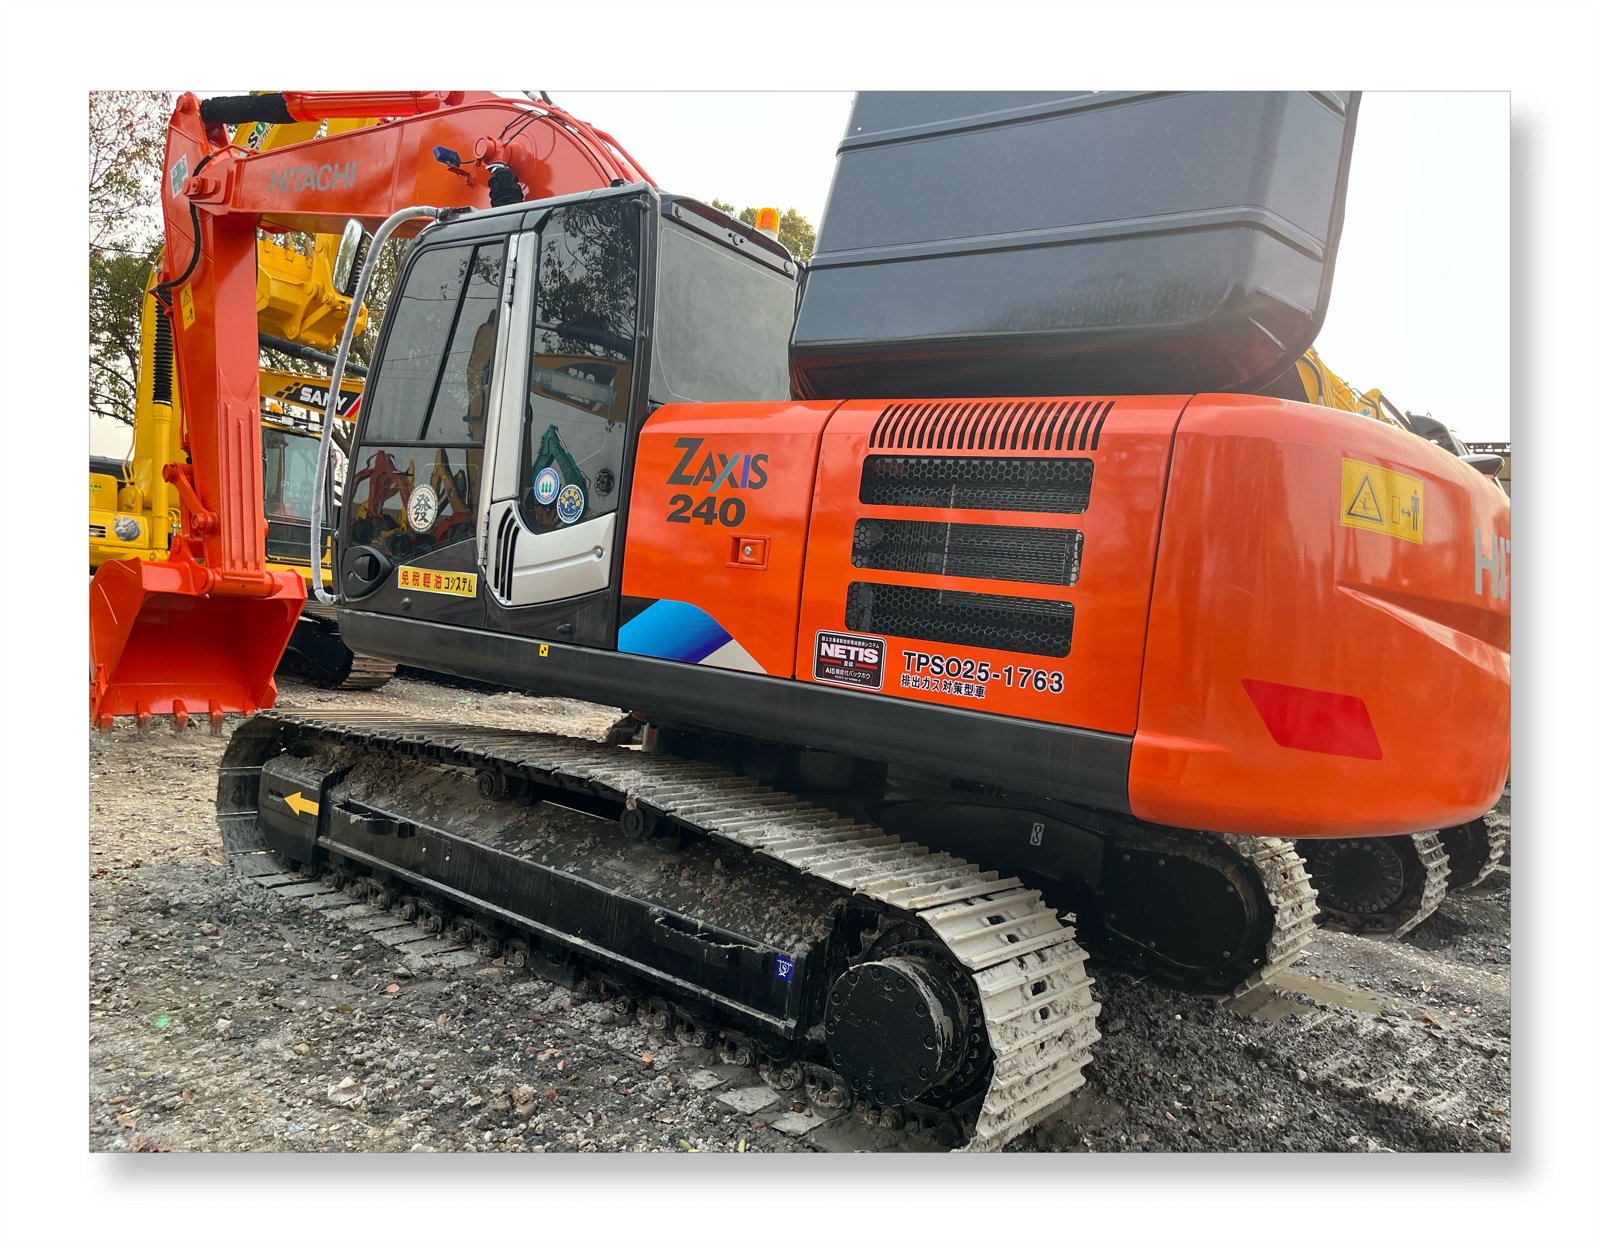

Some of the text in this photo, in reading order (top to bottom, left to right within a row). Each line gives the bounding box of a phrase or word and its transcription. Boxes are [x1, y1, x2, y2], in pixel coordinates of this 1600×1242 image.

[269, 161, 358, 194] HITACHI
[666, 437, 769, 493] ZAXIS
[666, 494, 746, 527] 240
[820, 642, 879, 664] NETIS
